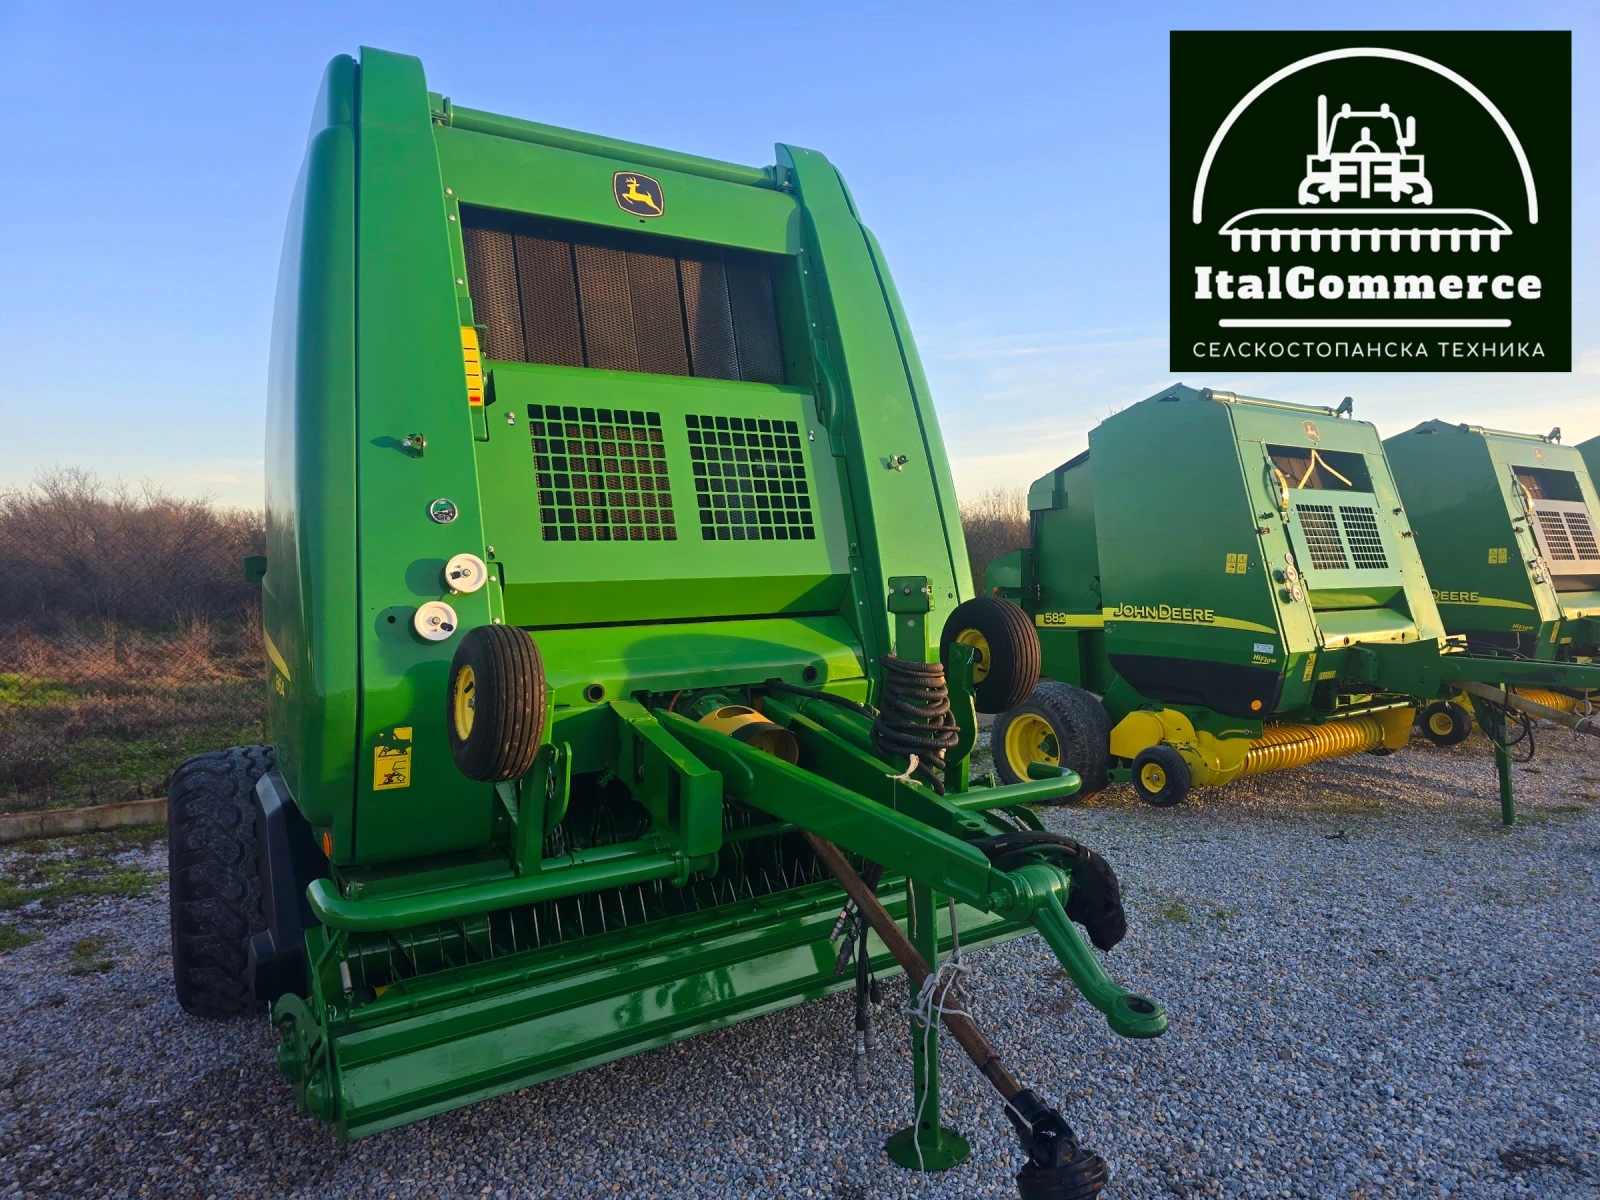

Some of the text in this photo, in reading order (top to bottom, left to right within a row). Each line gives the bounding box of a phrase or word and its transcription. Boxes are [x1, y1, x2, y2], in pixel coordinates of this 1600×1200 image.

[1044, 613, 1066, 624] 582
[1115, 602, 1216, 622] JOHN DEERE
